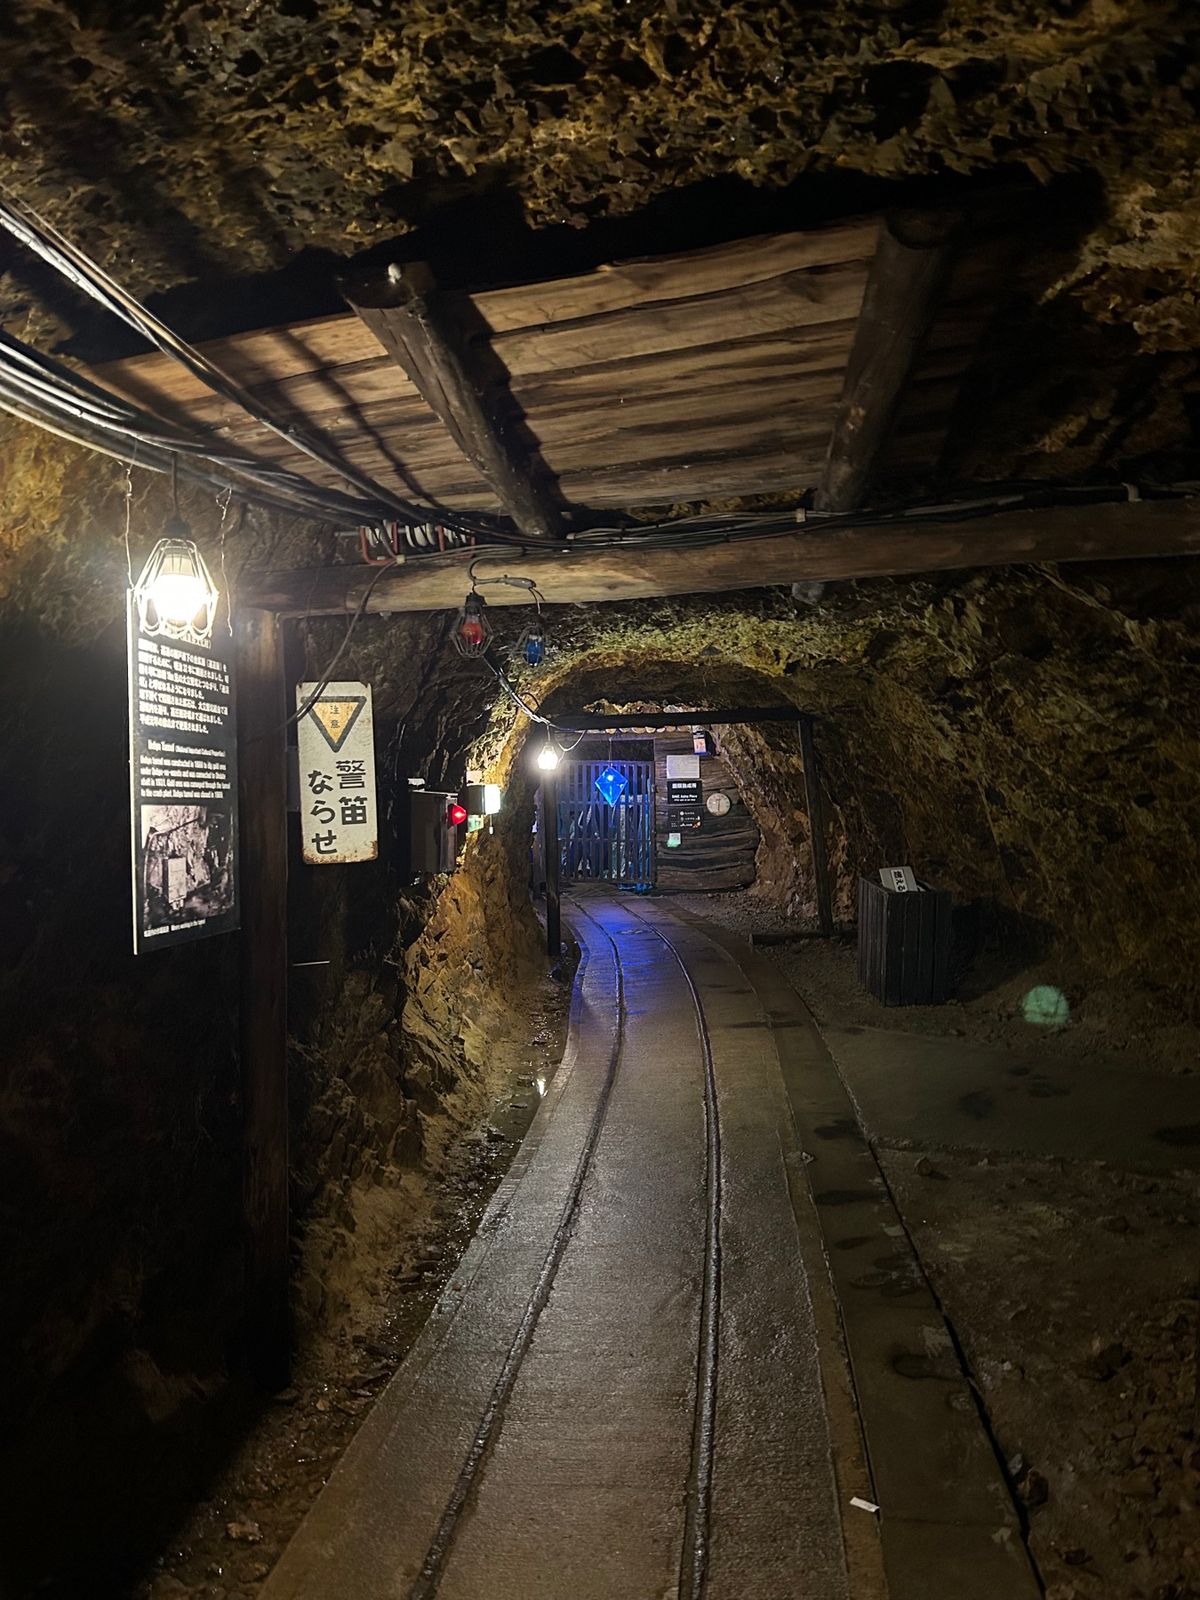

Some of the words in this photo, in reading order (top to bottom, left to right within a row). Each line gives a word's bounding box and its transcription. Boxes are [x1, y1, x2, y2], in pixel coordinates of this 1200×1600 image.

[330, 705, 340, 729] 注意
[308, 770, 338, 855] ならせ
[336, 760, 368, 826] 警笛
